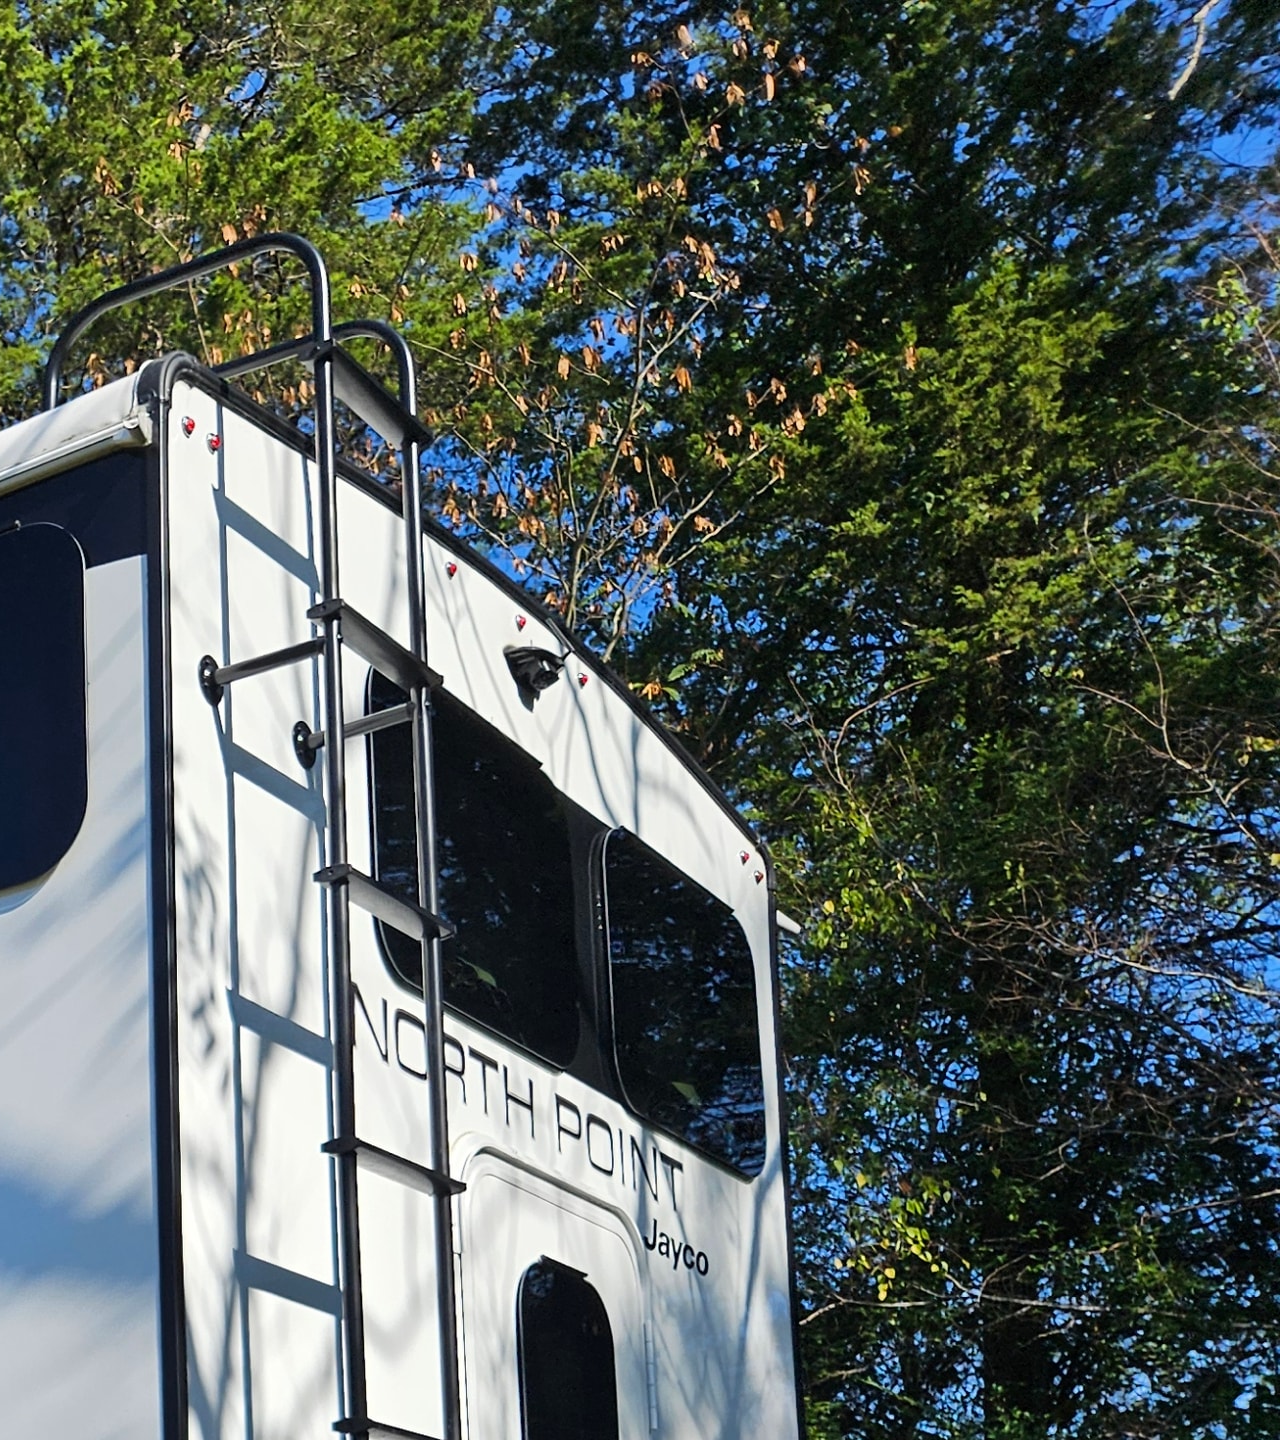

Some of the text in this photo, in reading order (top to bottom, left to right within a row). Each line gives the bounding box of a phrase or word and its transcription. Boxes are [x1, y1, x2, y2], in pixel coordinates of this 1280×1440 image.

[351, 981, 683, 1212] NORTH POINT
[643, 1218, 710, 1276] Jayco
